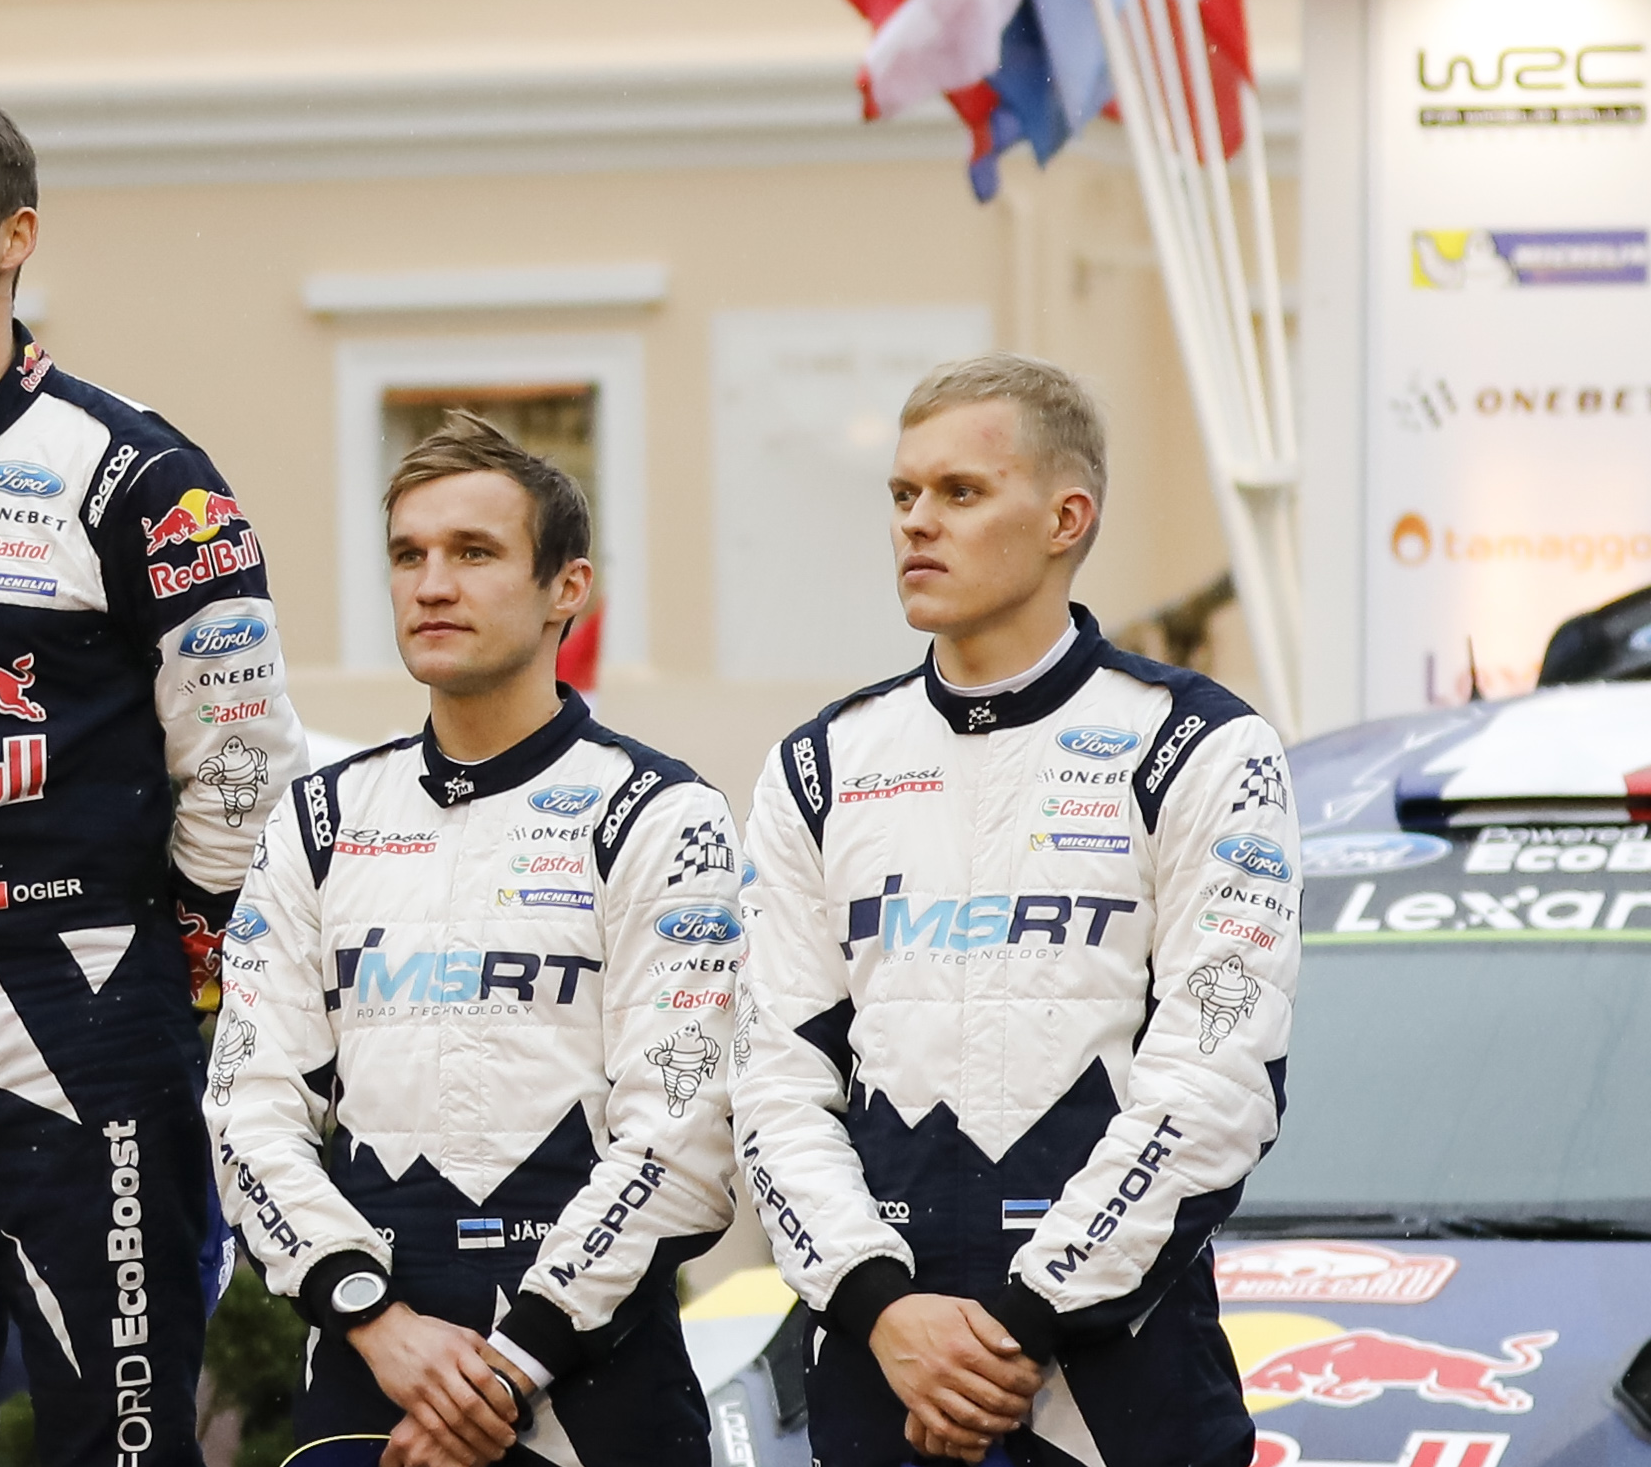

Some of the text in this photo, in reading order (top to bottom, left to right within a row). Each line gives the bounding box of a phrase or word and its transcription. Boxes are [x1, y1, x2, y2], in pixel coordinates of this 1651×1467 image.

[1417, 44, 1645, 91] WRC
[87, 444, 138, 526] sparco
[148, 529, 262, 600] Red Bull
[191, 621, 255, 651] Ford
[199, 662, 275, 687] ONEBET
[1067, 729, 1129, 756] Ford
[1146, 714, 1207, 794] sparco
[794, 737, 824, 815] sparco
[842, 766, 944, 792] Grossi
[1060, 768, 1128, 785] ONEBE
[304, 775, 335, 848] sparco
[540, 789, 595, 812] Ford
[601, 770, 662, 848] sparco
[1060, 797, 1123, 819] Castrol
[531, 825, 592, 841] ONEBE
[1058, 834, 1130, 851] MICHELIN
[1479, 826, 1650, 847] Powered
[530, 855, 586, 874] Castrol
[1229, 839, 1291, 878] Ford
[12, 878, 84, 902] OGIER
[526, 890, 594, 906] MICHELIN
[1221, 885, 1296, 923] ONEBET
[666, 909, 729, 940] Ford
[880, 897, 1138, 949] MSRT
[1218, 917, 1277, 951] Castrol
[222, 949, 269, 973] NEBET
[668, 957, 737, 974] ONEBE
[930, 949, 1064, 966] TECHNOLOGY
[357, 950, 603, 1005] MSRT
[357, 1005, 536, 1018] ROAD TECHNOLOGY
[671, 988, 731, 1011] Castrol
[102, 1119, 151, 1347] EcoBoost
